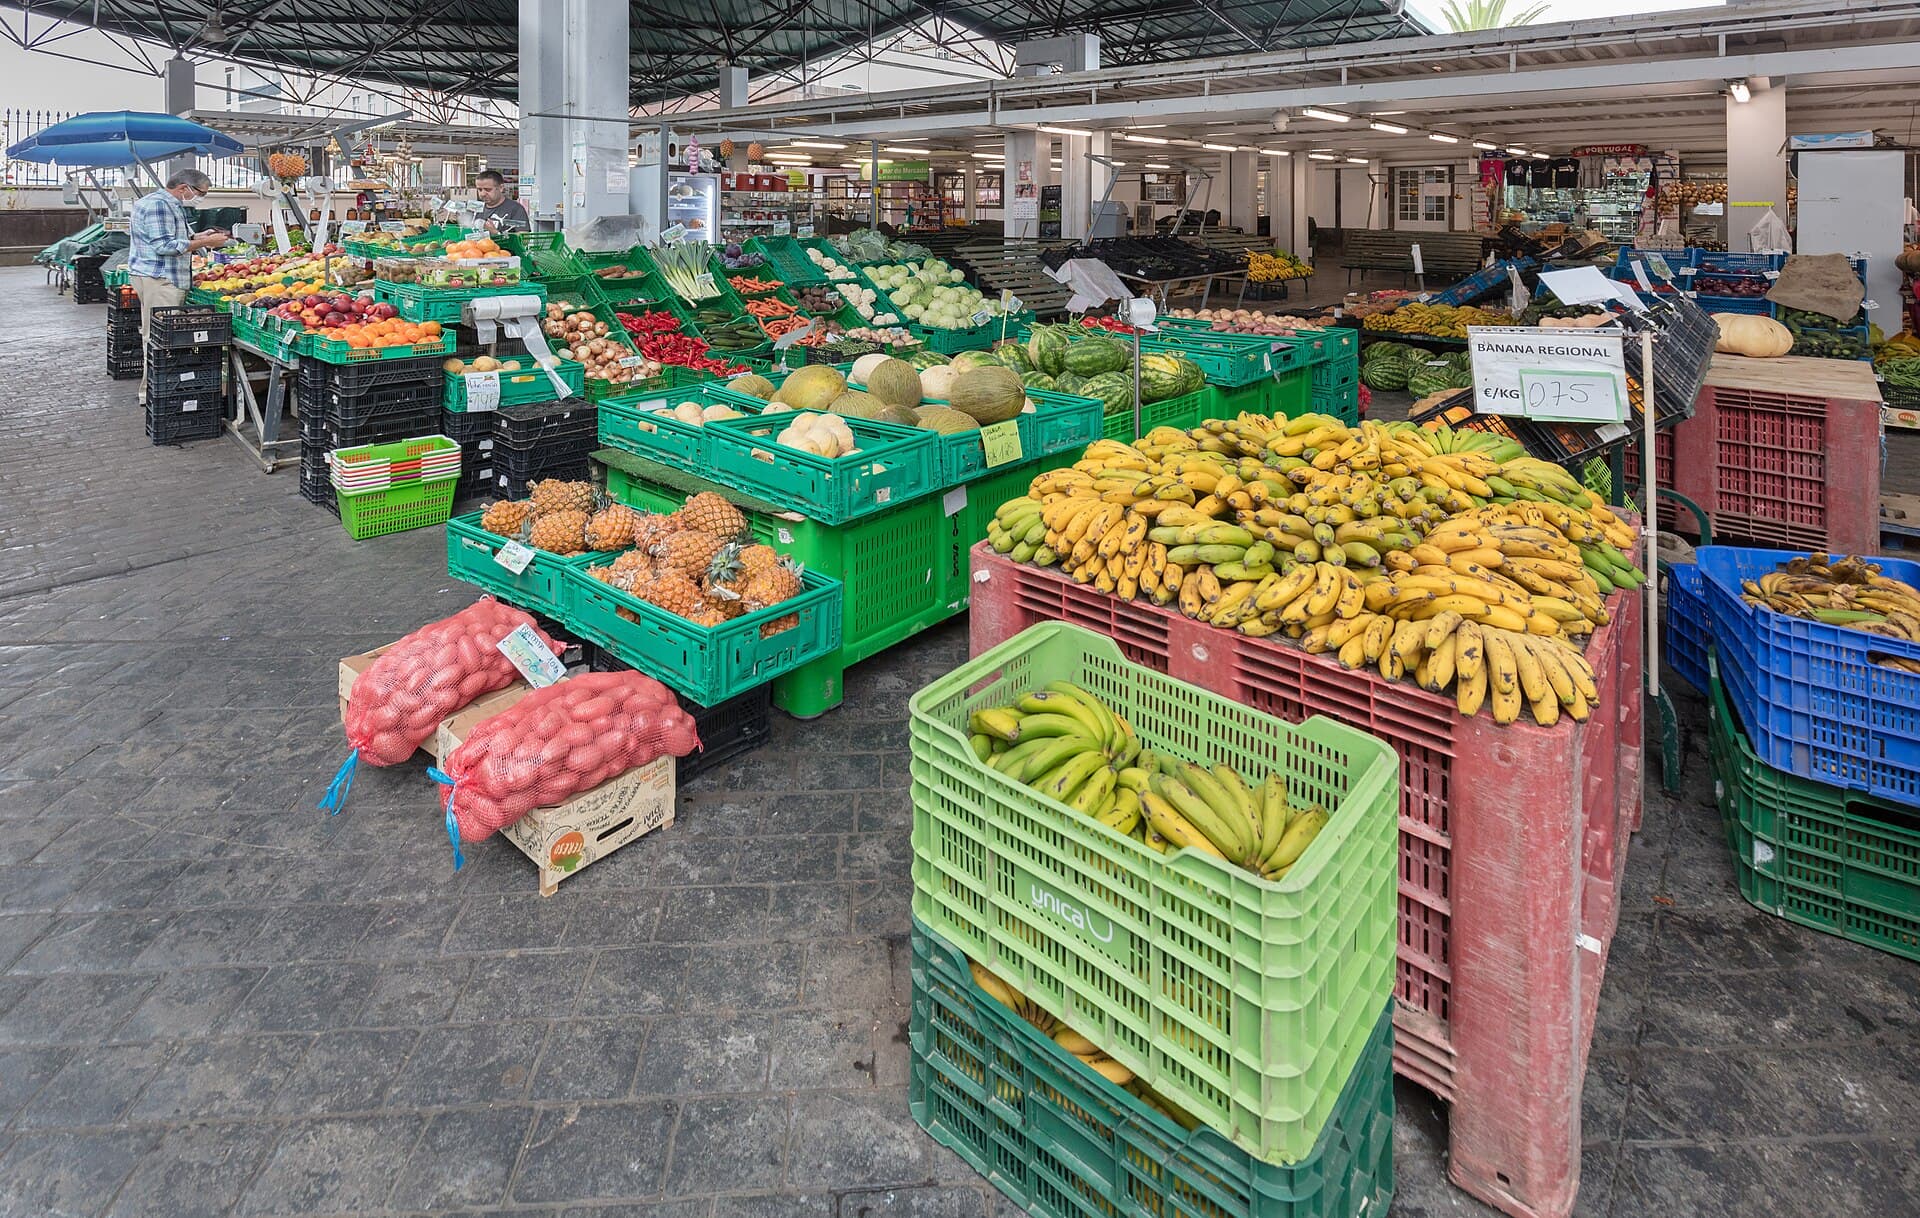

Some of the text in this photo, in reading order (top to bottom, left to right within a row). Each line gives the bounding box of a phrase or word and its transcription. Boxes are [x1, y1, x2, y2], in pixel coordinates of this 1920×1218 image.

[1585, 146, 1633, 154] PORTUGAL
[1477, 343, 1611, 358] BANANA REGIONAL
[1483, 387, 1520, 400] €/KG
[554, 841, 584, 856] TERESO
